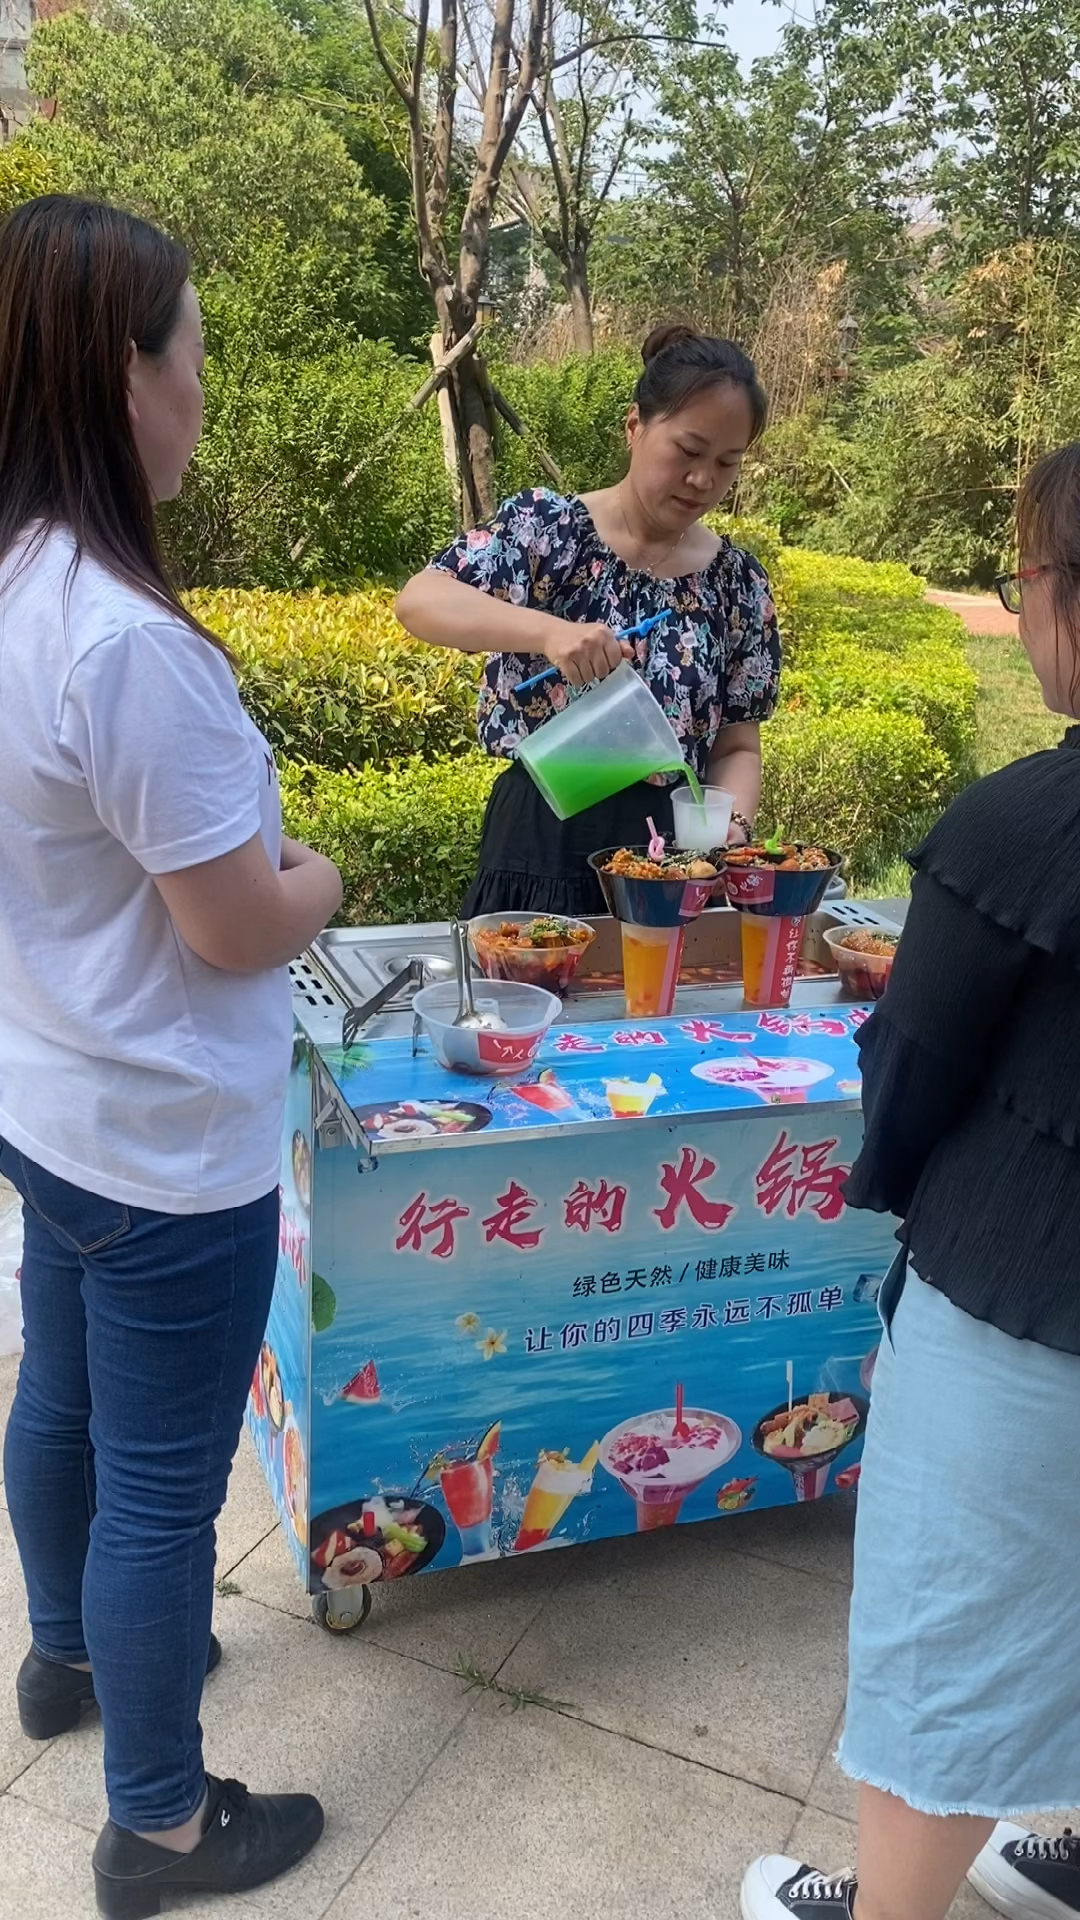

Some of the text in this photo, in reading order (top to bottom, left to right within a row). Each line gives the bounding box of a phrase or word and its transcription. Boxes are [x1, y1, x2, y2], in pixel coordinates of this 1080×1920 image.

[396, 1130, 850, 1258] 行走的火锅
[524, 1286, 843, 1353] 让你的四季永远不孤单
